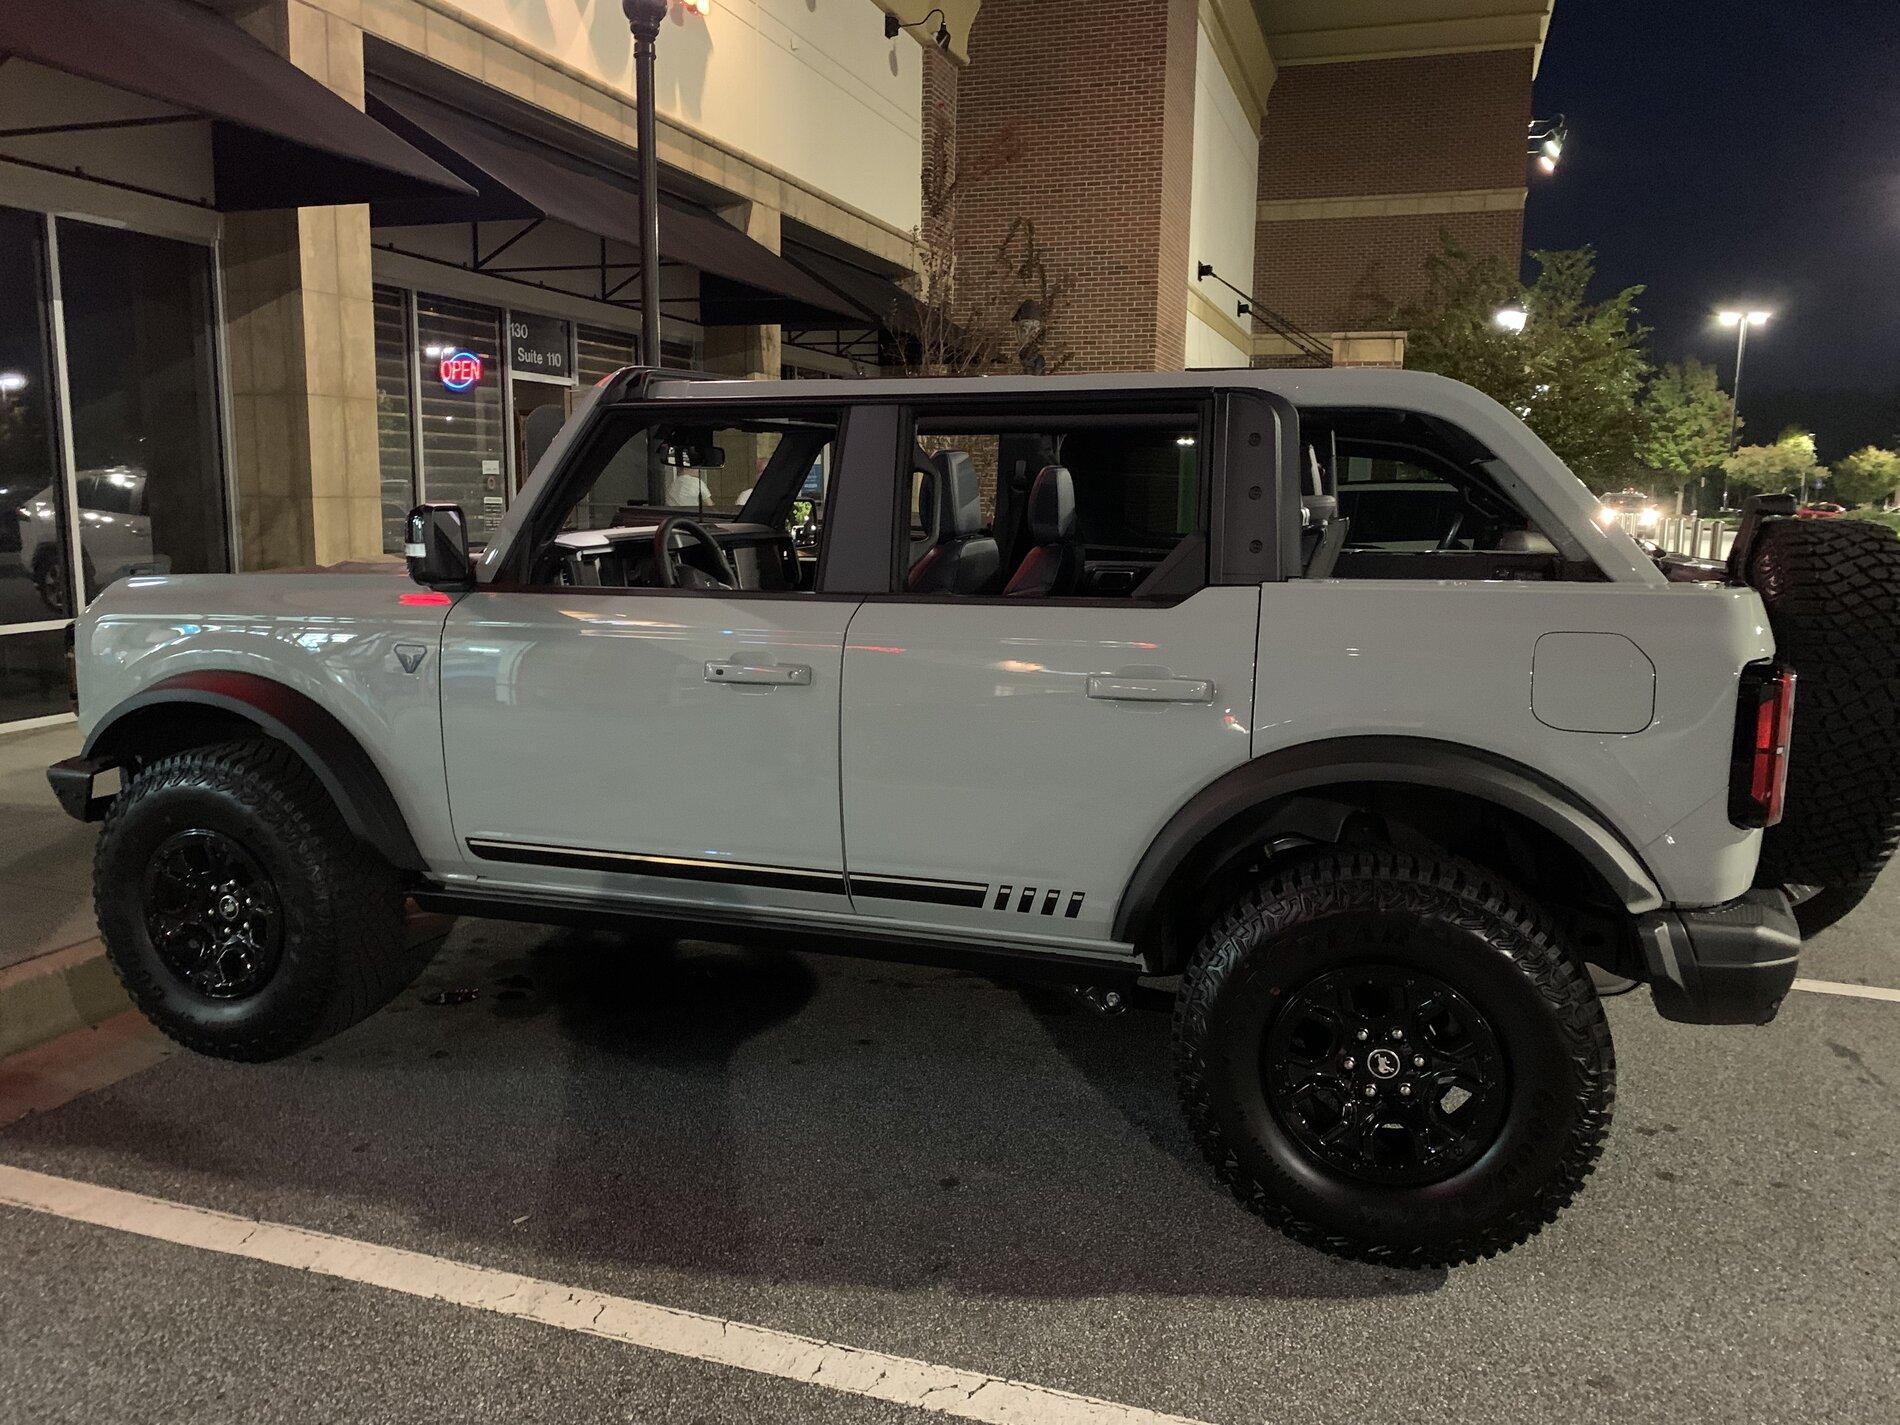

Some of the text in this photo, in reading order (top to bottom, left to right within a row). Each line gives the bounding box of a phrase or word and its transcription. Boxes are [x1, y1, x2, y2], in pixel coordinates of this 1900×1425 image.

[517, 347, 562, 367] Suite 110
[441, 360, 480, 380] OPEN
